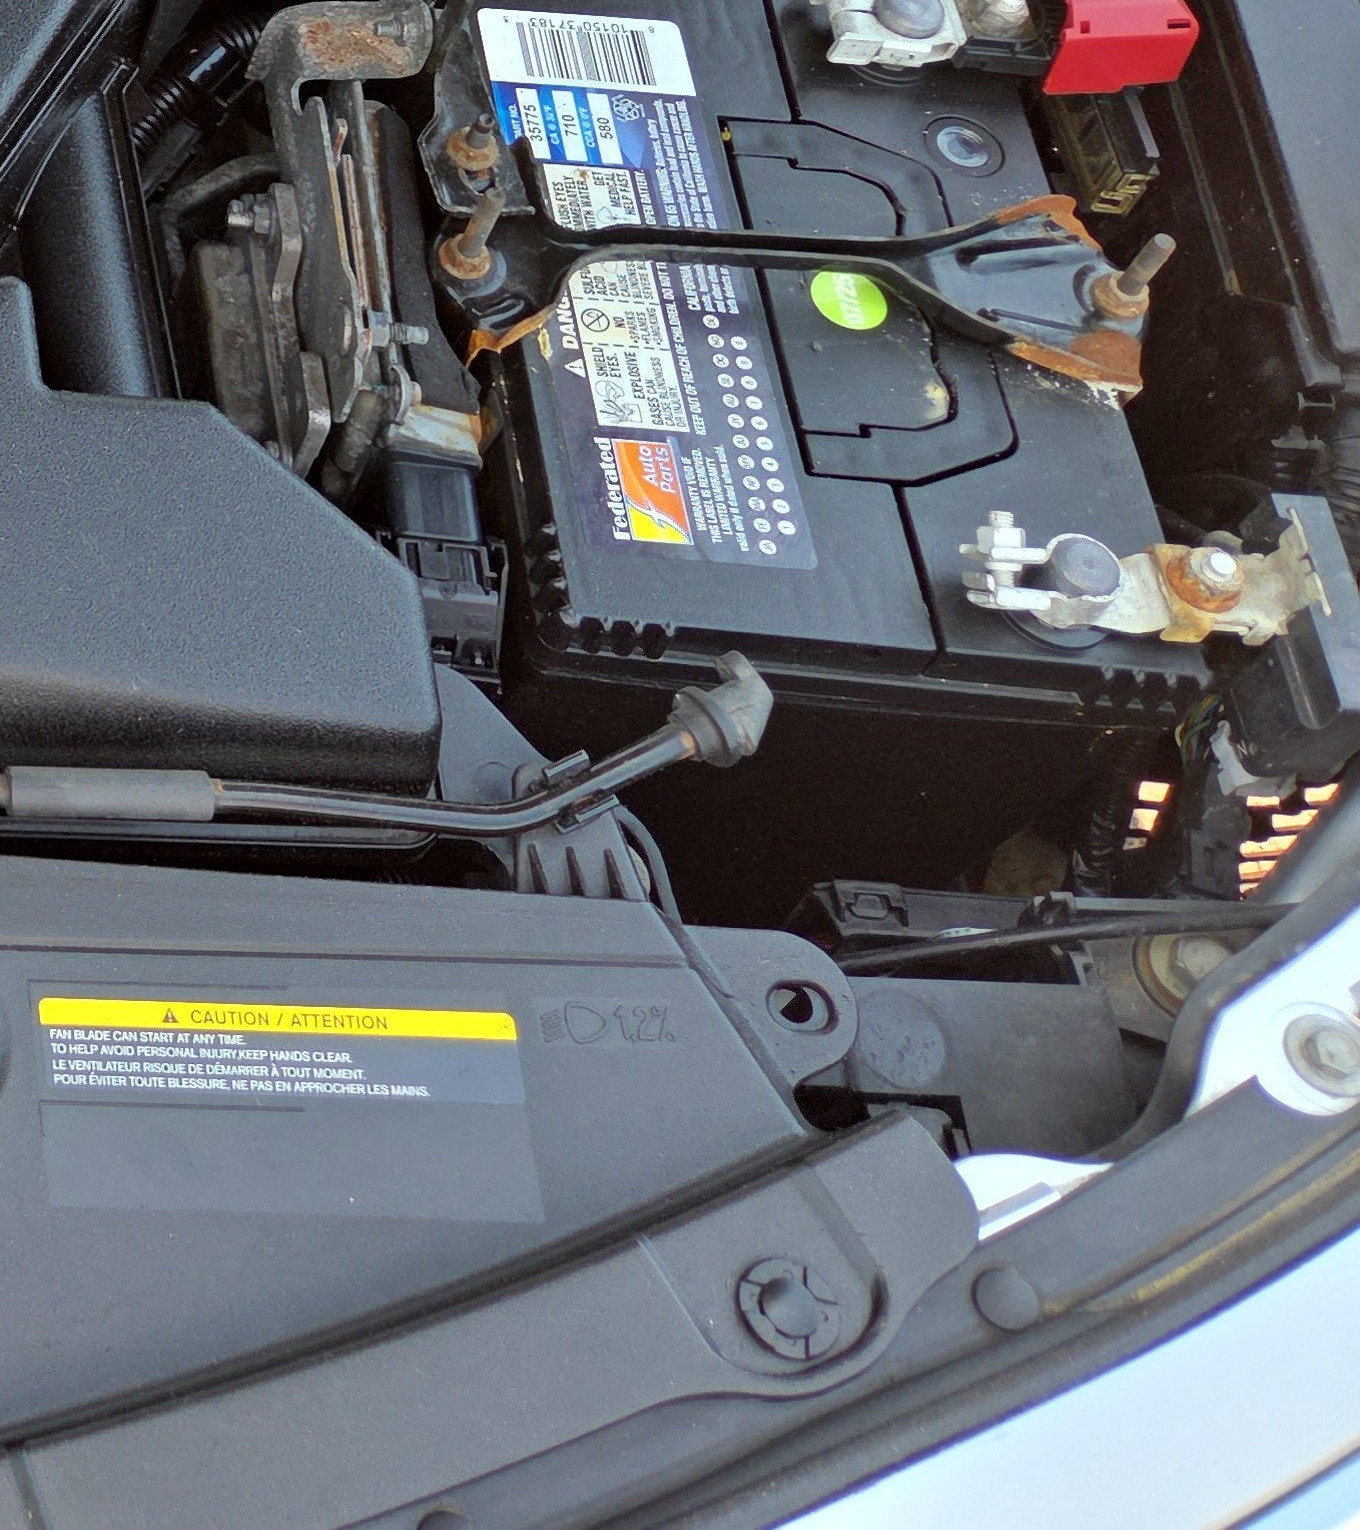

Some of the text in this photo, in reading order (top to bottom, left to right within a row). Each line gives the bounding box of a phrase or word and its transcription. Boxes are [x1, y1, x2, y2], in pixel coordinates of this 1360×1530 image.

[529, 17, 575, 29] 37183
[583, 21, 627, 33] 10150
[523, 104, 543, 141] 35775
[561, 114, 578, 136] 710
[596, 117, 613, 139] 580
[552, 181, 565, 201] EYES
[591, 171, 605, 186] GET
[605, 173, 622, 207] MEDICAL
[616, 172, 636, 214] HELP FAST.
[579, 262, 595, 294] SULFU
[593, 275, 607, 295] ACID
[834, 274, 865, 325] 07/25
[555, 289, 579, 349] DANG
[612, 316, 626, 328] NO
[591, 347, 608, 377] SHIELD
[606, 353, 622, 378] EYES.
[678, 356, 694, 383] REACH
[624, 352, 645, 399] EXPLOSIVE
[645, 379, 664, 425] GASES CAN
[687, 396, 702, 413] OUT
[691, 414, 707, 435] KEEP
[638, 445, 658, 484] Auto
[655, 447, 675, 493] Parts
[594, 437, 630, 540] Federated
[190, 1010, 269, 1025] CAUTION
[292, 1013, 387, 1029] ATTENTION
[49, 1029, 71, 1039] FAN
[73, 1029, 110, 1041] BLADE
[112, 1031, 137, 1042] CAN
[139, 1032, 174, 1043] START
[176, 1033, 190, 1043] AT
[192, 1034, 215, 1044] ANY
[51, 1043, 66, 1053] TO
[69, 1043, 98, 1054] HELP
[100, 1045, 134, 1055] AVOID
[137, 1046, 197, 1057] PERSONAL
[270, 1050, 310, 1061] HANDS
[312, 1052, 352, 1062] CLEAR.
[52, 1059, 364, 1079] LE VENTILATEUR RISQUE DE DÉMARRER À TOUT MOMENT.
[53, 1073, 87, 1085] POUR
[88, 1072, 126, 1086] ÉVITER
[129, 1076, 165, 1087] TOUTE
[232, 1079, 248, 1090] NE
[250, 1080, 271, 1091] PAS
[275, 1081, 291, 1091] EN
[294, 1082, 364, 1094] APPROCHER
[367, 1084, 388, 1095] LES
[391, 1085, 429, 1097] MAINS.
